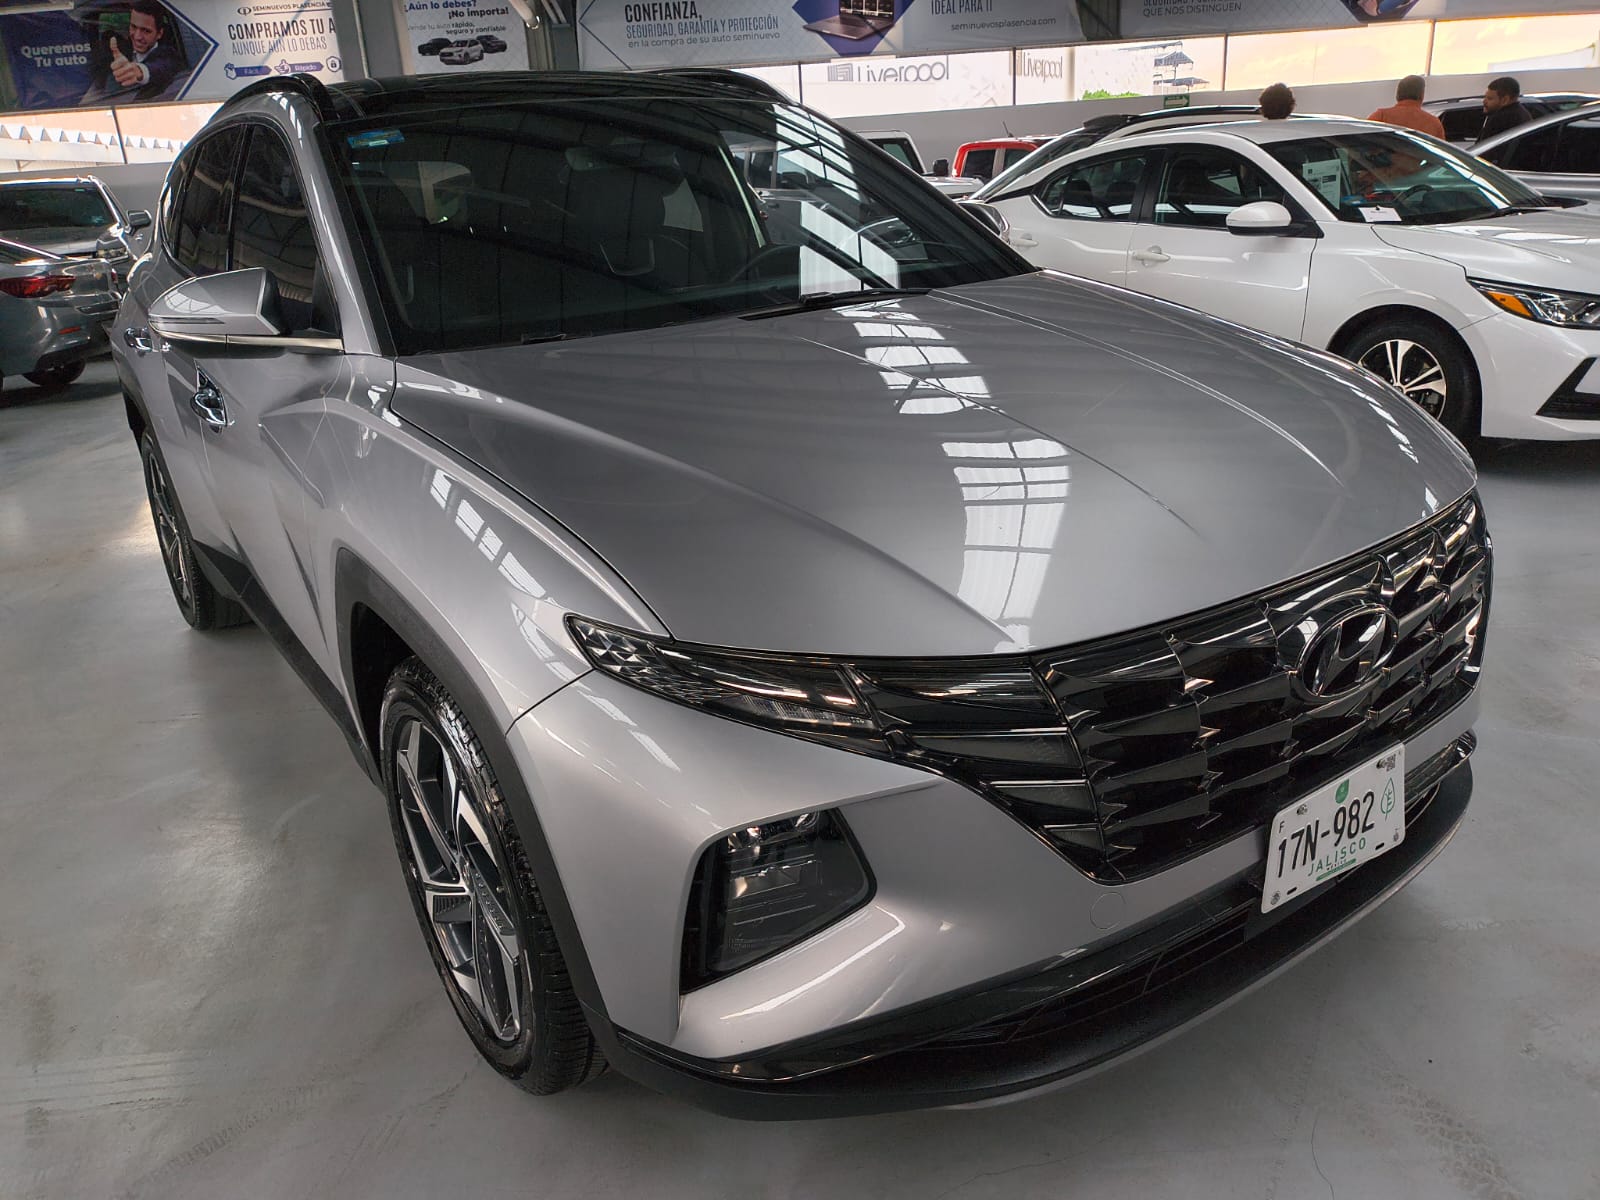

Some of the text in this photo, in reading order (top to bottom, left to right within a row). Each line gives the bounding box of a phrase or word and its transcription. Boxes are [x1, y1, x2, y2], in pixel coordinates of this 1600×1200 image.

[252, 4, 291, 12] SEMINUEVOS
[431, 1, 440, 10] lo
[442, 0, 477, 9] debes?
[624, 0, 702, 23] CONFIANZA,
[931, 0, 956, 15] IDEAL
[959, 0, 983, 13] PARA
[1143, 7, 1163, 17] QUE
[1165, 5, 1185, 15] NOS
[1187, 2, 1242, 14] DISTINGUEN
[448, 6, 509, 20] ¡No importa!
[228, 20, 308, 41] COMPRAMOS
[309, 18, 325, 35] TU
[476, 25, 506, 33] confiable
[626, 13, 779, 39] SEGURIDAD, GARANTÍA Y PROTECCIÓN
[951, 16, 1057, 31] seminuevosplasencia.com
[232, 40, 267, 56] AUNQUE
[287, 37, 297, 52] LO
[300, 35, 328, 51] DEBAS
[628, 31, 781, 48] en la compra de su auto seminuevo
[21, 43, 91, 58] Queremos
[34, 55, 87, 68] Tu auto
[1022, 52, 1063, 83] Liverpool
[1278, 791, 1375, 879] 17N-982
[1308, 837, 1366, 878] JALISCO
